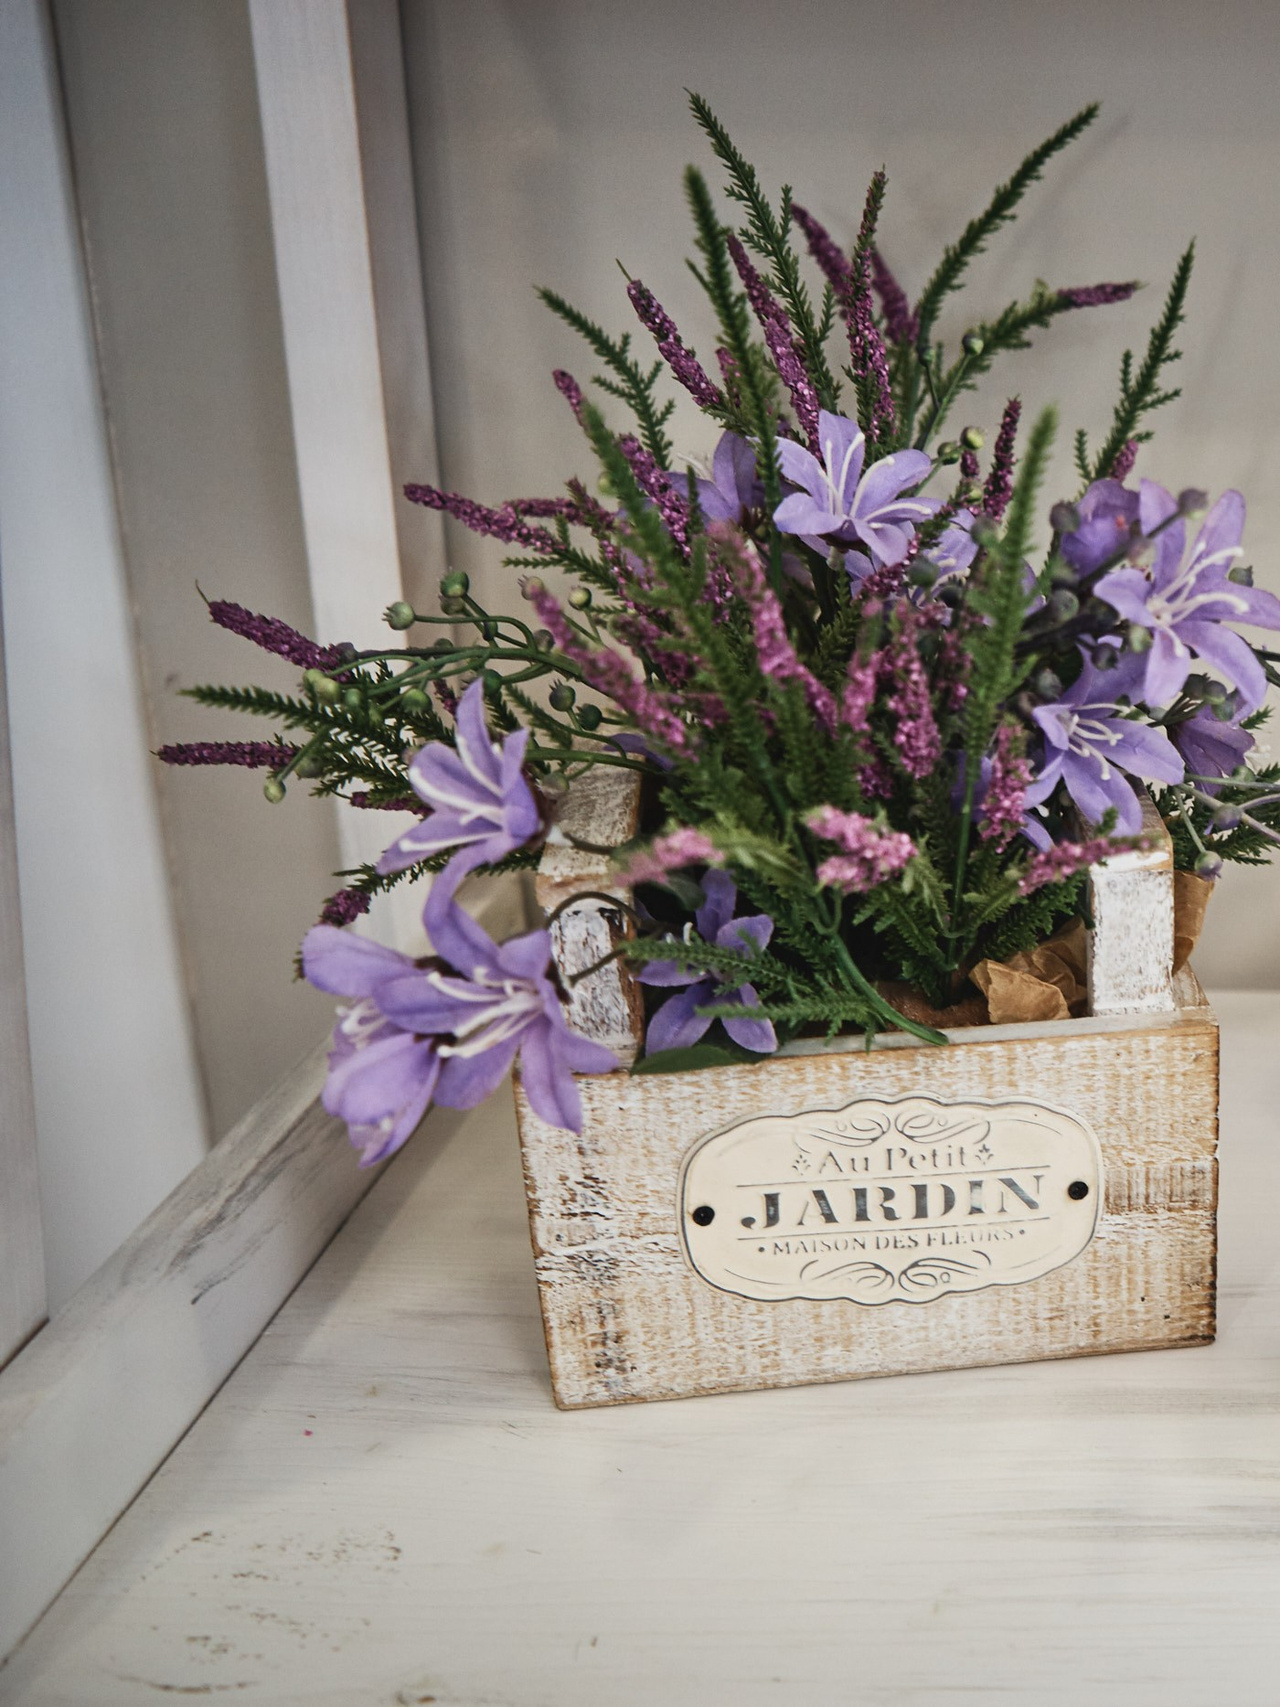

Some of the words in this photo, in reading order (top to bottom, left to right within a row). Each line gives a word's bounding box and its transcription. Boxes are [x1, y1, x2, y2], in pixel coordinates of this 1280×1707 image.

[819, 1150, 870, 1174] Au
[886, 1144, 967, 1171] Petit
[740, 1174, 1046, 1230] JARDIN
[773, 1235, 867, 1255] MAISON
[876, 1233, 919, 1250] DES
[927, 1228, 1014, 1246] FLEURS
